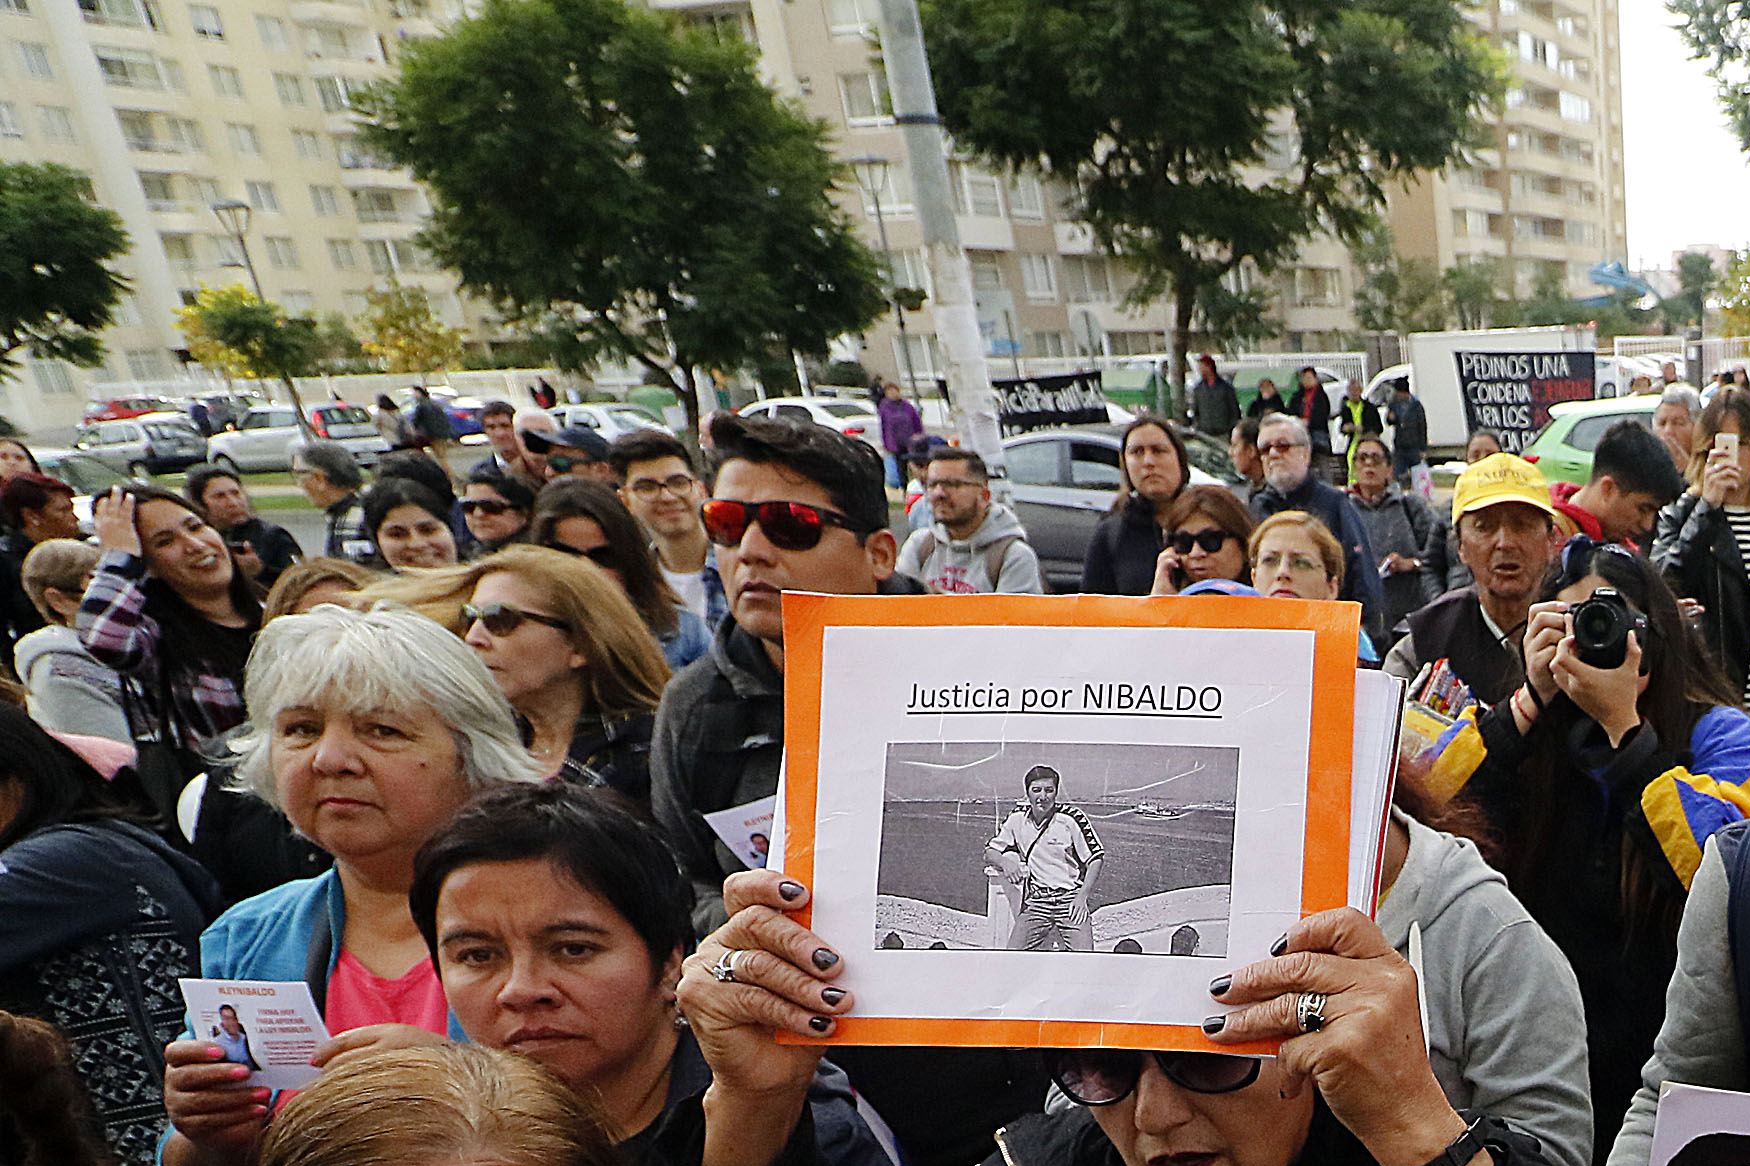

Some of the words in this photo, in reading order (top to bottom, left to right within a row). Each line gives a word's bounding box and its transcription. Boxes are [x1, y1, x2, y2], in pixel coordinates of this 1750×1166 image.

[1461, 352, 1531, 380] PEDIMOS
[1533, 353, 1571, 380] UNA
[1466, 381, 1532, 404] CONDENA
[1502, 405, 1533, 428] LOS
[907, 682, 1010, 709] Justicia
[1021, 687, 1073, 712] por
[1083, 683, 1222, 712] NIBALDO
[218, 987, 277, 996] #LEYNIBALDO
